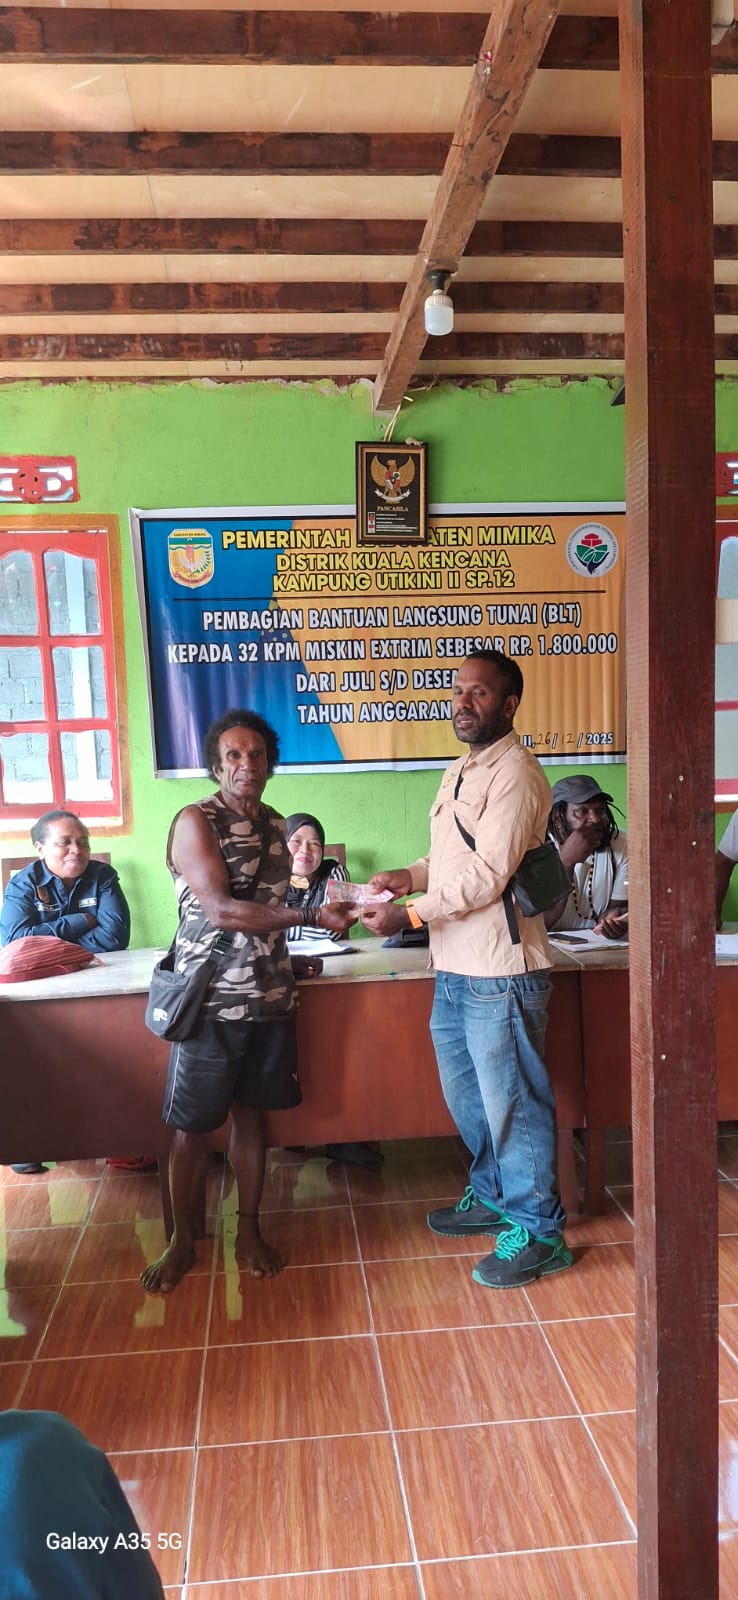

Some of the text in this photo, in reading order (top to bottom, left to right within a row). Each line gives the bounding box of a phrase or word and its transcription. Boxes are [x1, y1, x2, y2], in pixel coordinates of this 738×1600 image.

[222, 529, 351, 549] PEMERINTAH
[478, 525, 555, 546] MIMIKA
[276, 549, 511, 572] DISTRIK KUALA KENCANA
[272, 570, 515, 593] KAMPUNG UTIKINI II SP.12
[202, 602, 581, 631] PEMBAGIAN BANTUAN LANGSUNG TUNAI (BLT)
[167, 633, 617, 664] KEPADA 32 KPM MISKIN EXTRIM SEBESAR RP. 1.800.000
[296, 668, 459, 695] DARI JULI S/D DESE
[297, 700, 452, 724] TAHUN ANGGARAN
